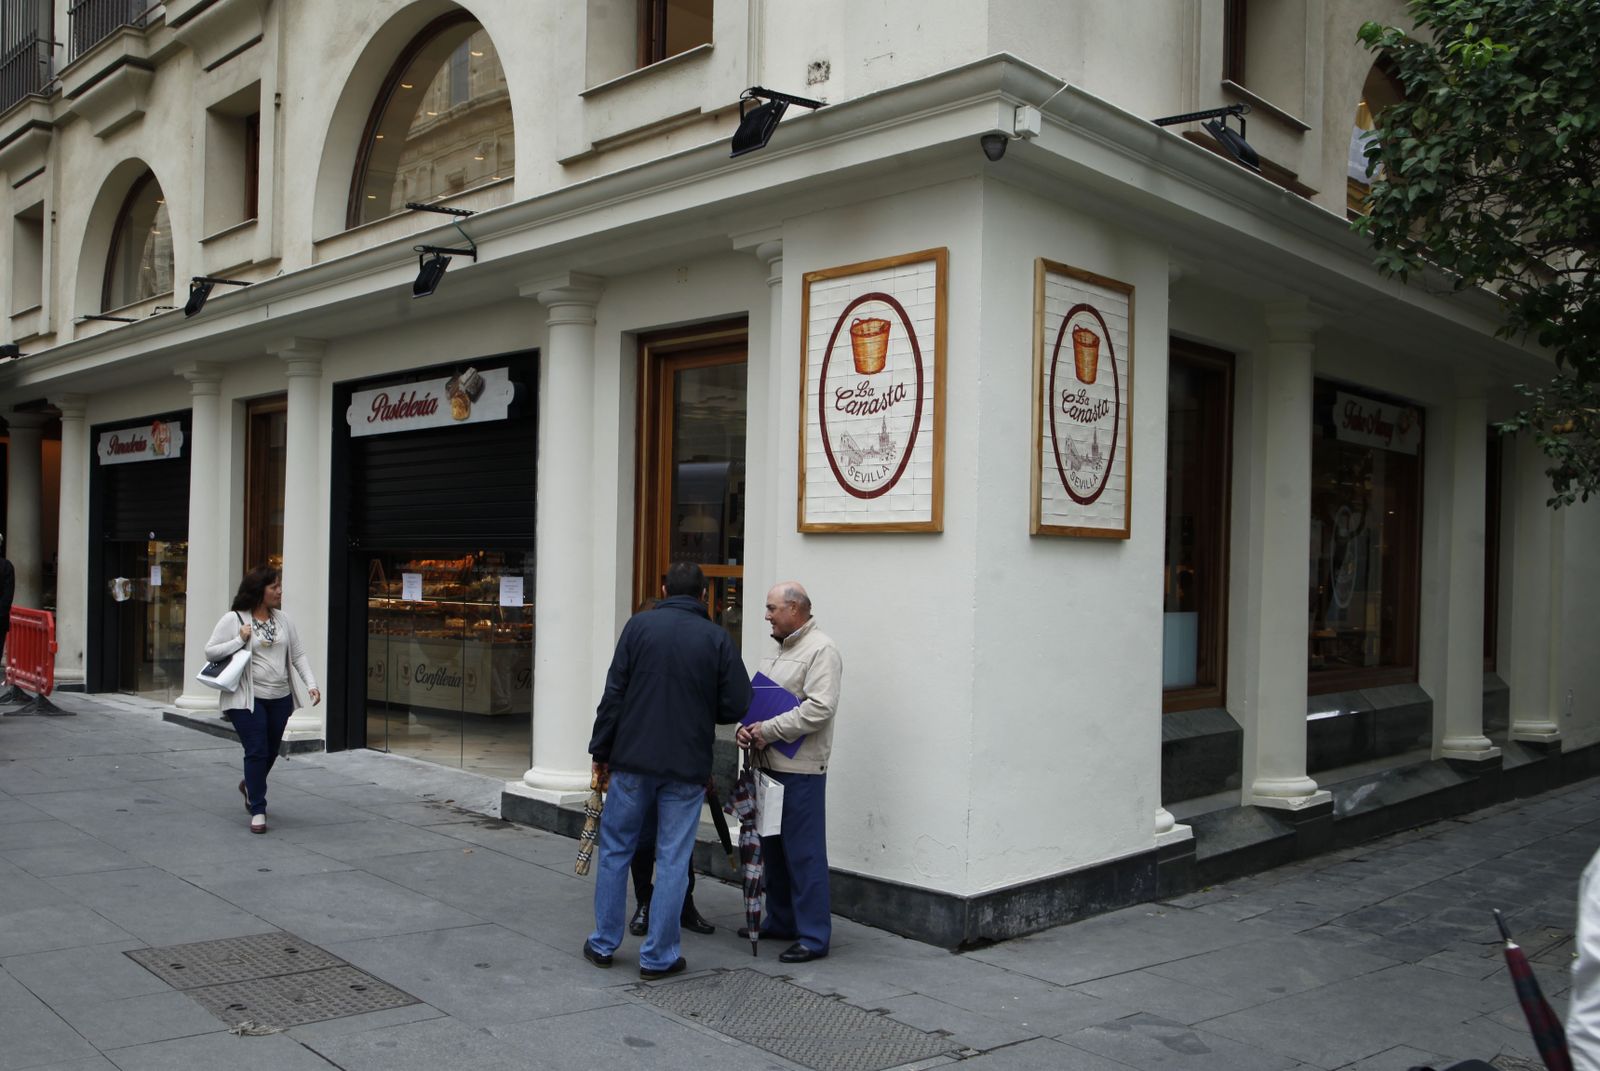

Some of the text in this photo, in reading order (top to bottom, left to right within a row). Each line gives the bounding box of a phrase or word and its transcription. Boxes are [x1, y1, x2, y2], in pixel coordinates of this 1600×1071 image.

[855, 380, 875, 397] La
[1075, 388, 1090, 405] La
[366, 390, 439, 424] Pastelería
[835, 382, 907, 416] Canasta
[1062, 389, 1110, 423] Canasta
[847, 465, 890, 483] SEVILLA
[1070, 471, 1098, 490] SEVILLA
